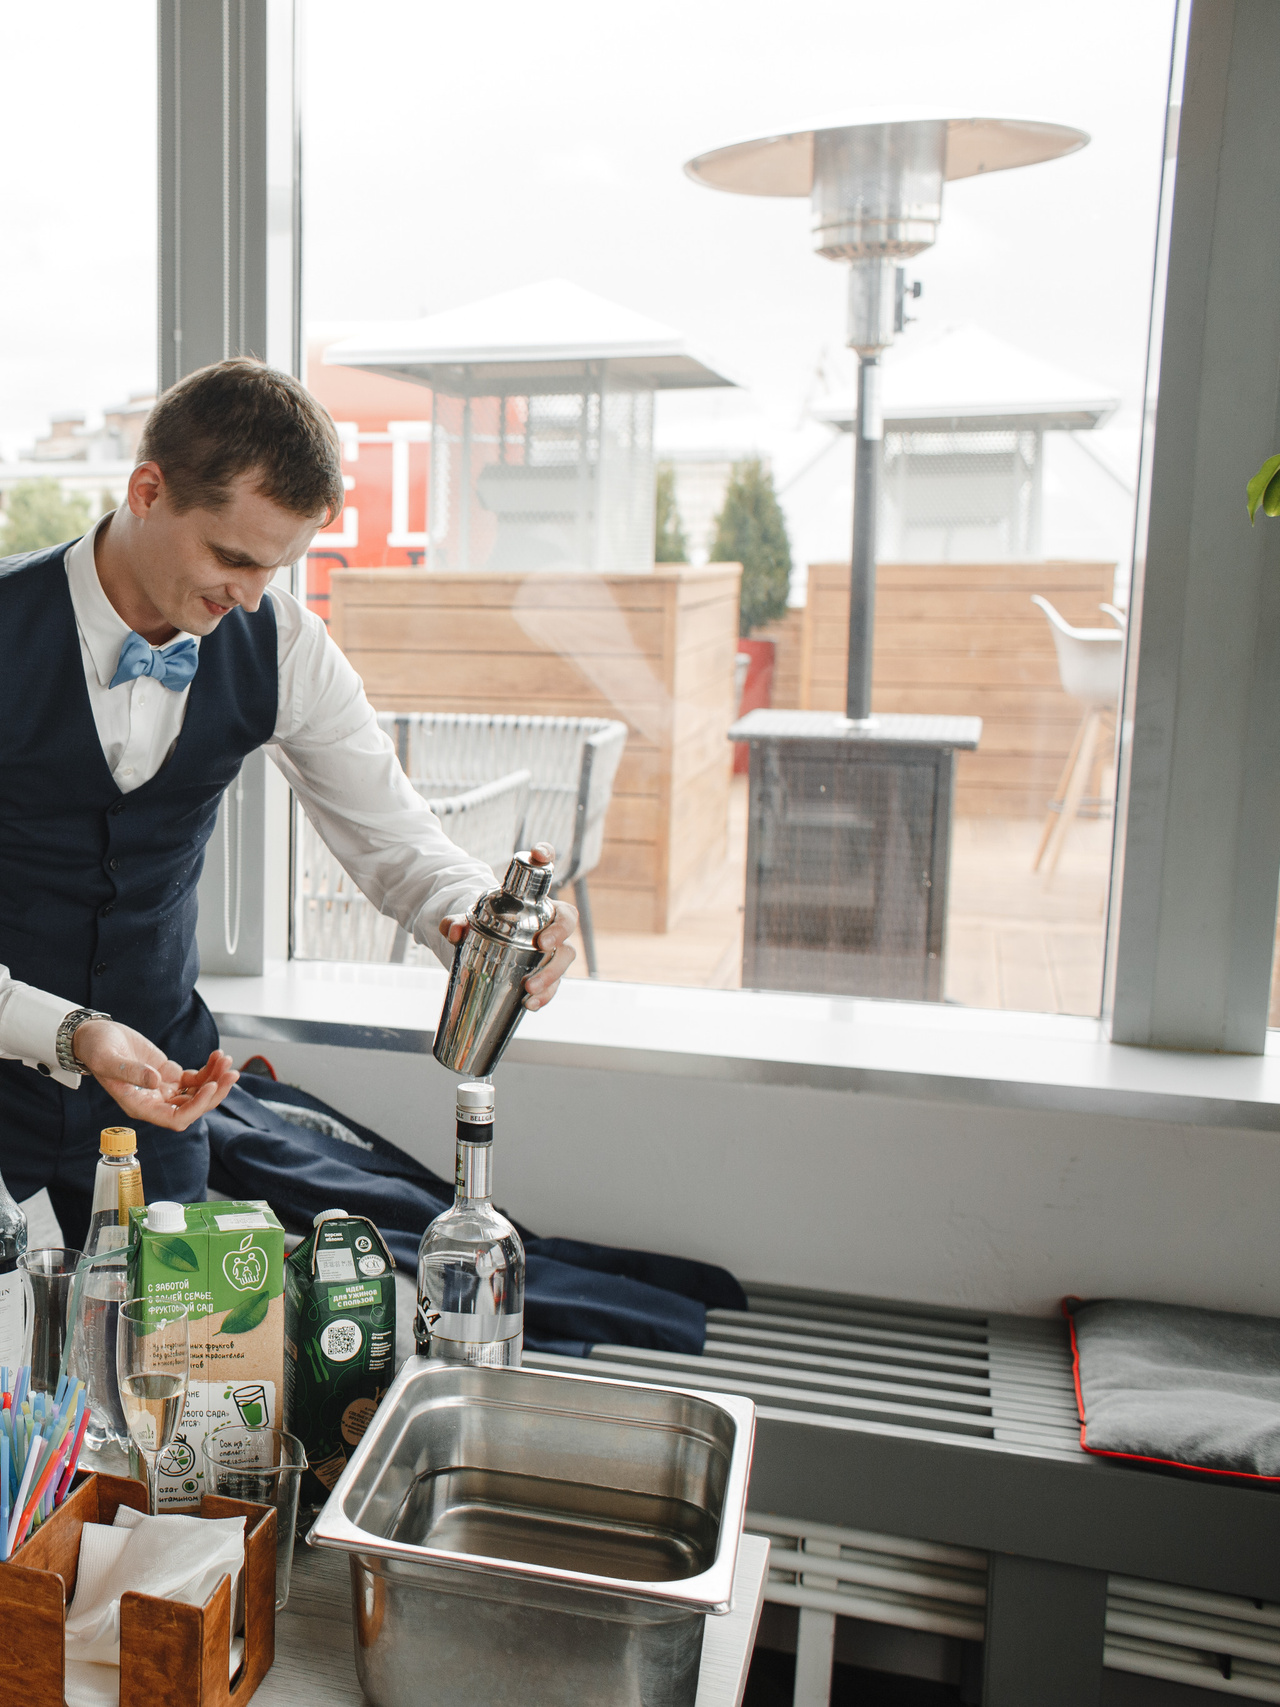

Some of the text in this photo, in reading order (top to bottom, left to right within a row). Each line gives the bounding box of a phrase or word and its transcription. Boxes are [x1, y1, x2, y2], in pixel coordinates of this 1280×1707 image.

[147, 1278, 190, 1293] С ЗАБОТОЙ
[345, 1285, 364, 1293] ИДЕИ
[184, 1290, 214, 1301] СЕМЬЕ.
[333, 1289, 378, 1303] ДЛЯ УЖИНОВ
[343, 1295, 375, 1306] ПОЛЬЗОЙ
[196, 1303, 214, 1314] САД
[219, 1439, 233, 1449] Сок
